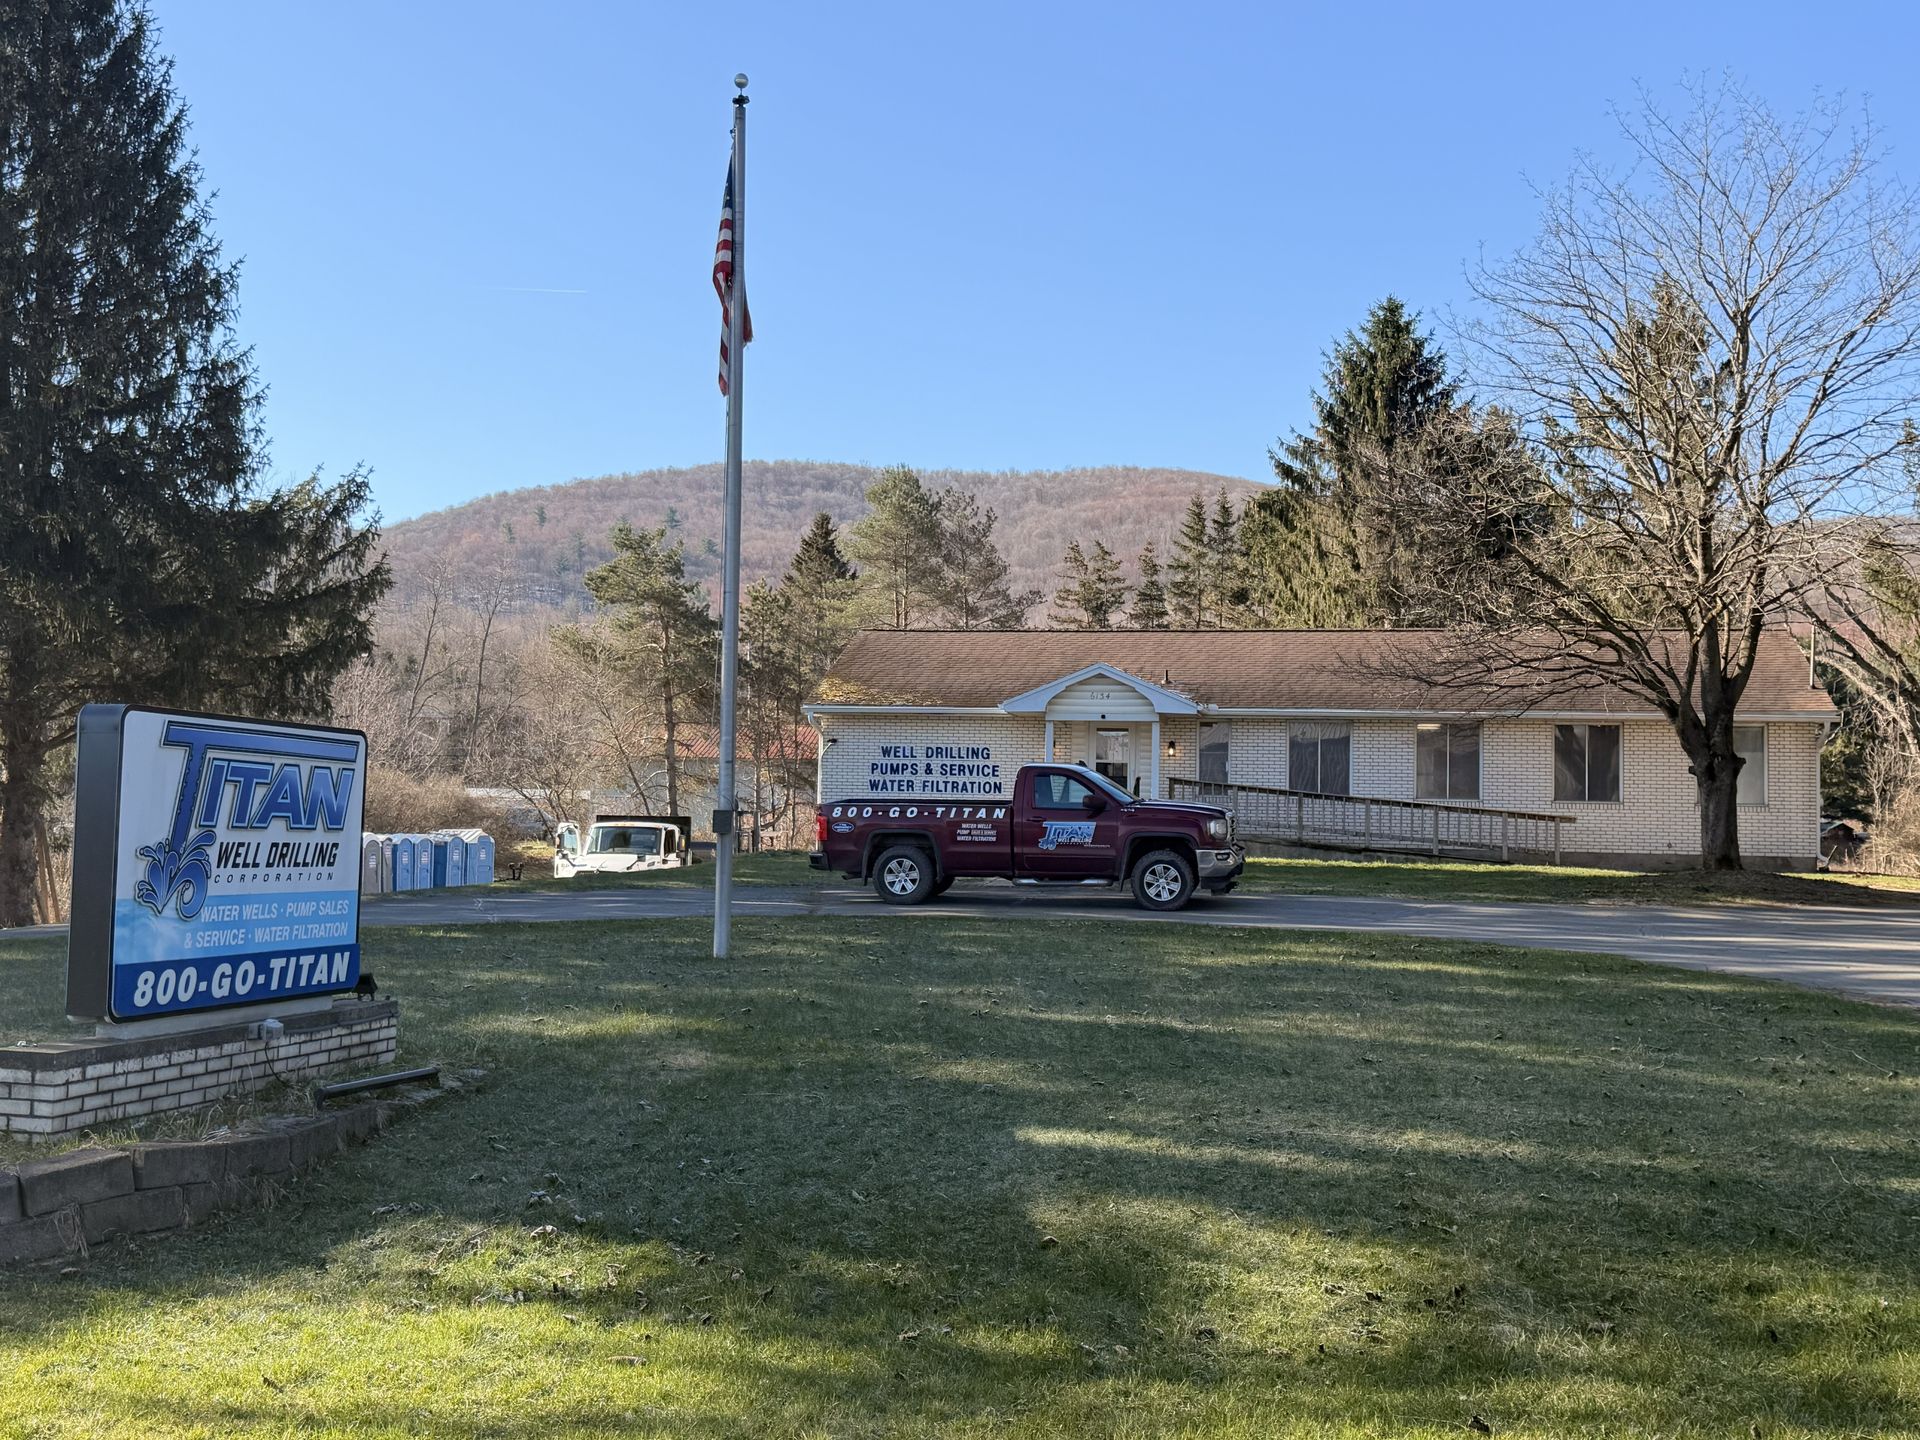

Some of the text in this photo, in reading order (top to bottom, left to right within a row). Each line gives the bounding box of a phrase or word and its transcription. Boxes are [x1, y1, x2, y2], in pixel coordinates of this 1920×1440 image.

[881, 745, 991, 760] WELL DRILLING
[871, 762, 1000, 777] PUMPS & SERVICE
[160, 720, 361, 852] TITAN
[869, 779, 1003, 794] WATER FILTRATION
[831, 806, 1006, 819] 800-GO-TITAN
[1042, 821, 1097, 841] TITAN
[216, 841, 263, 869] WELL
[265, 841, 340, 868] DRILLING
[214, 872, 334, 884] CORPORATION
[200, 900, 349, 923] WATER WELLS PUMP SALES
[183, 922, 348, 949] & SERVICE WATER FILTRATION
[133, 951, 351, 1008] 800-GO-TITAN
